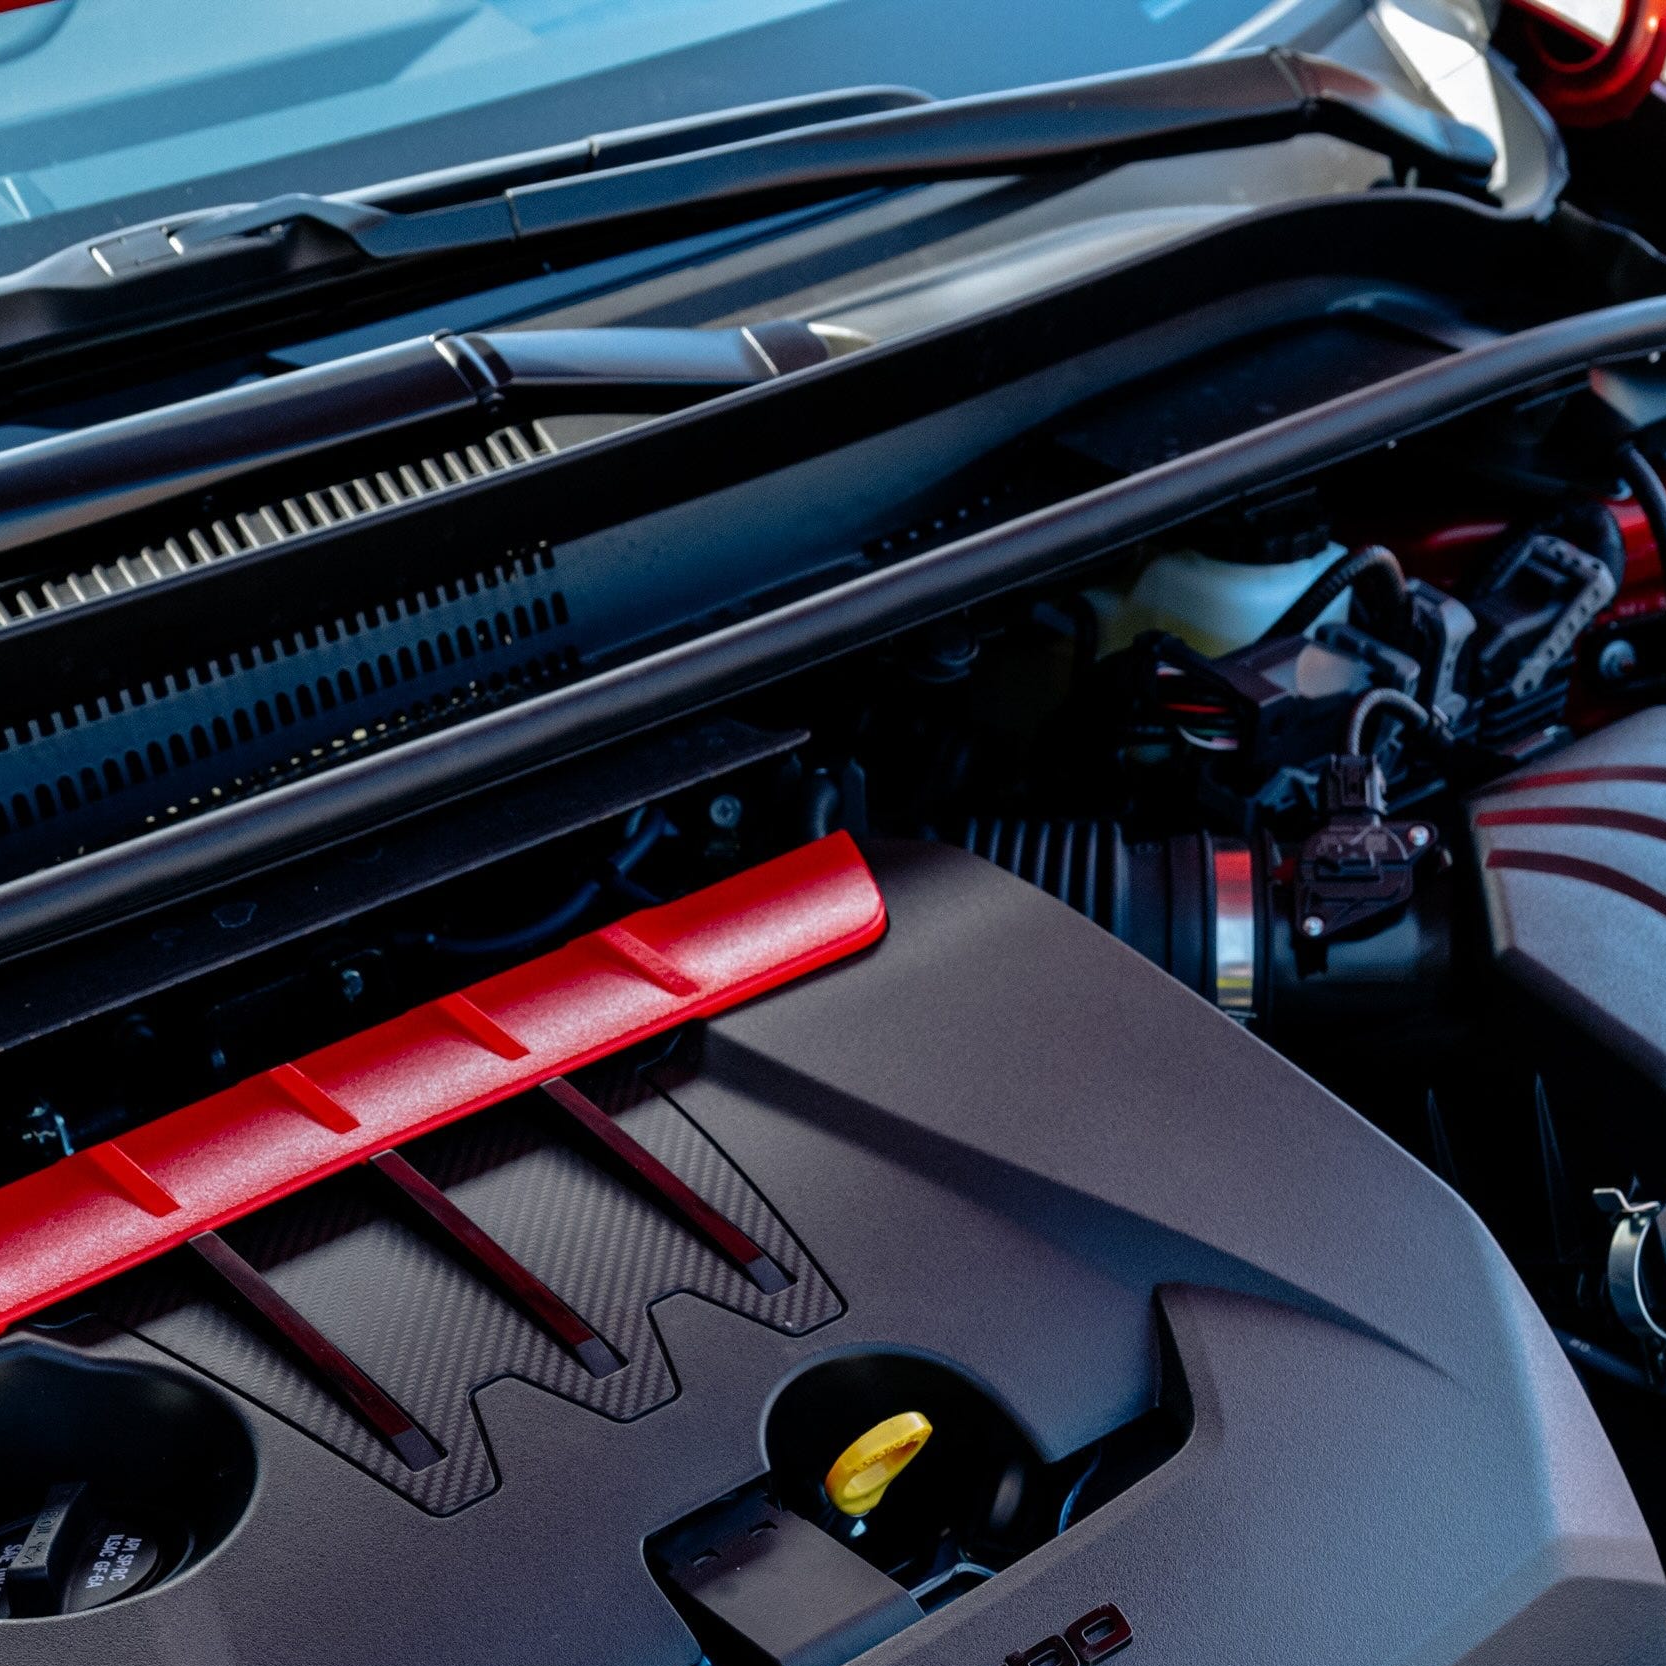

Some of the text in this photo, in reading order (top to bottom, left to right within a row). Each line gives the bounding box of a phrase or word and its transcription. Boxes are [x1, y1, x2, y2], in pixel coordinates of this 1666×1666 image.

[84, 1533, 124, 1589] ILSAC GF-6A
[123, 1536, 143, 1553] API
